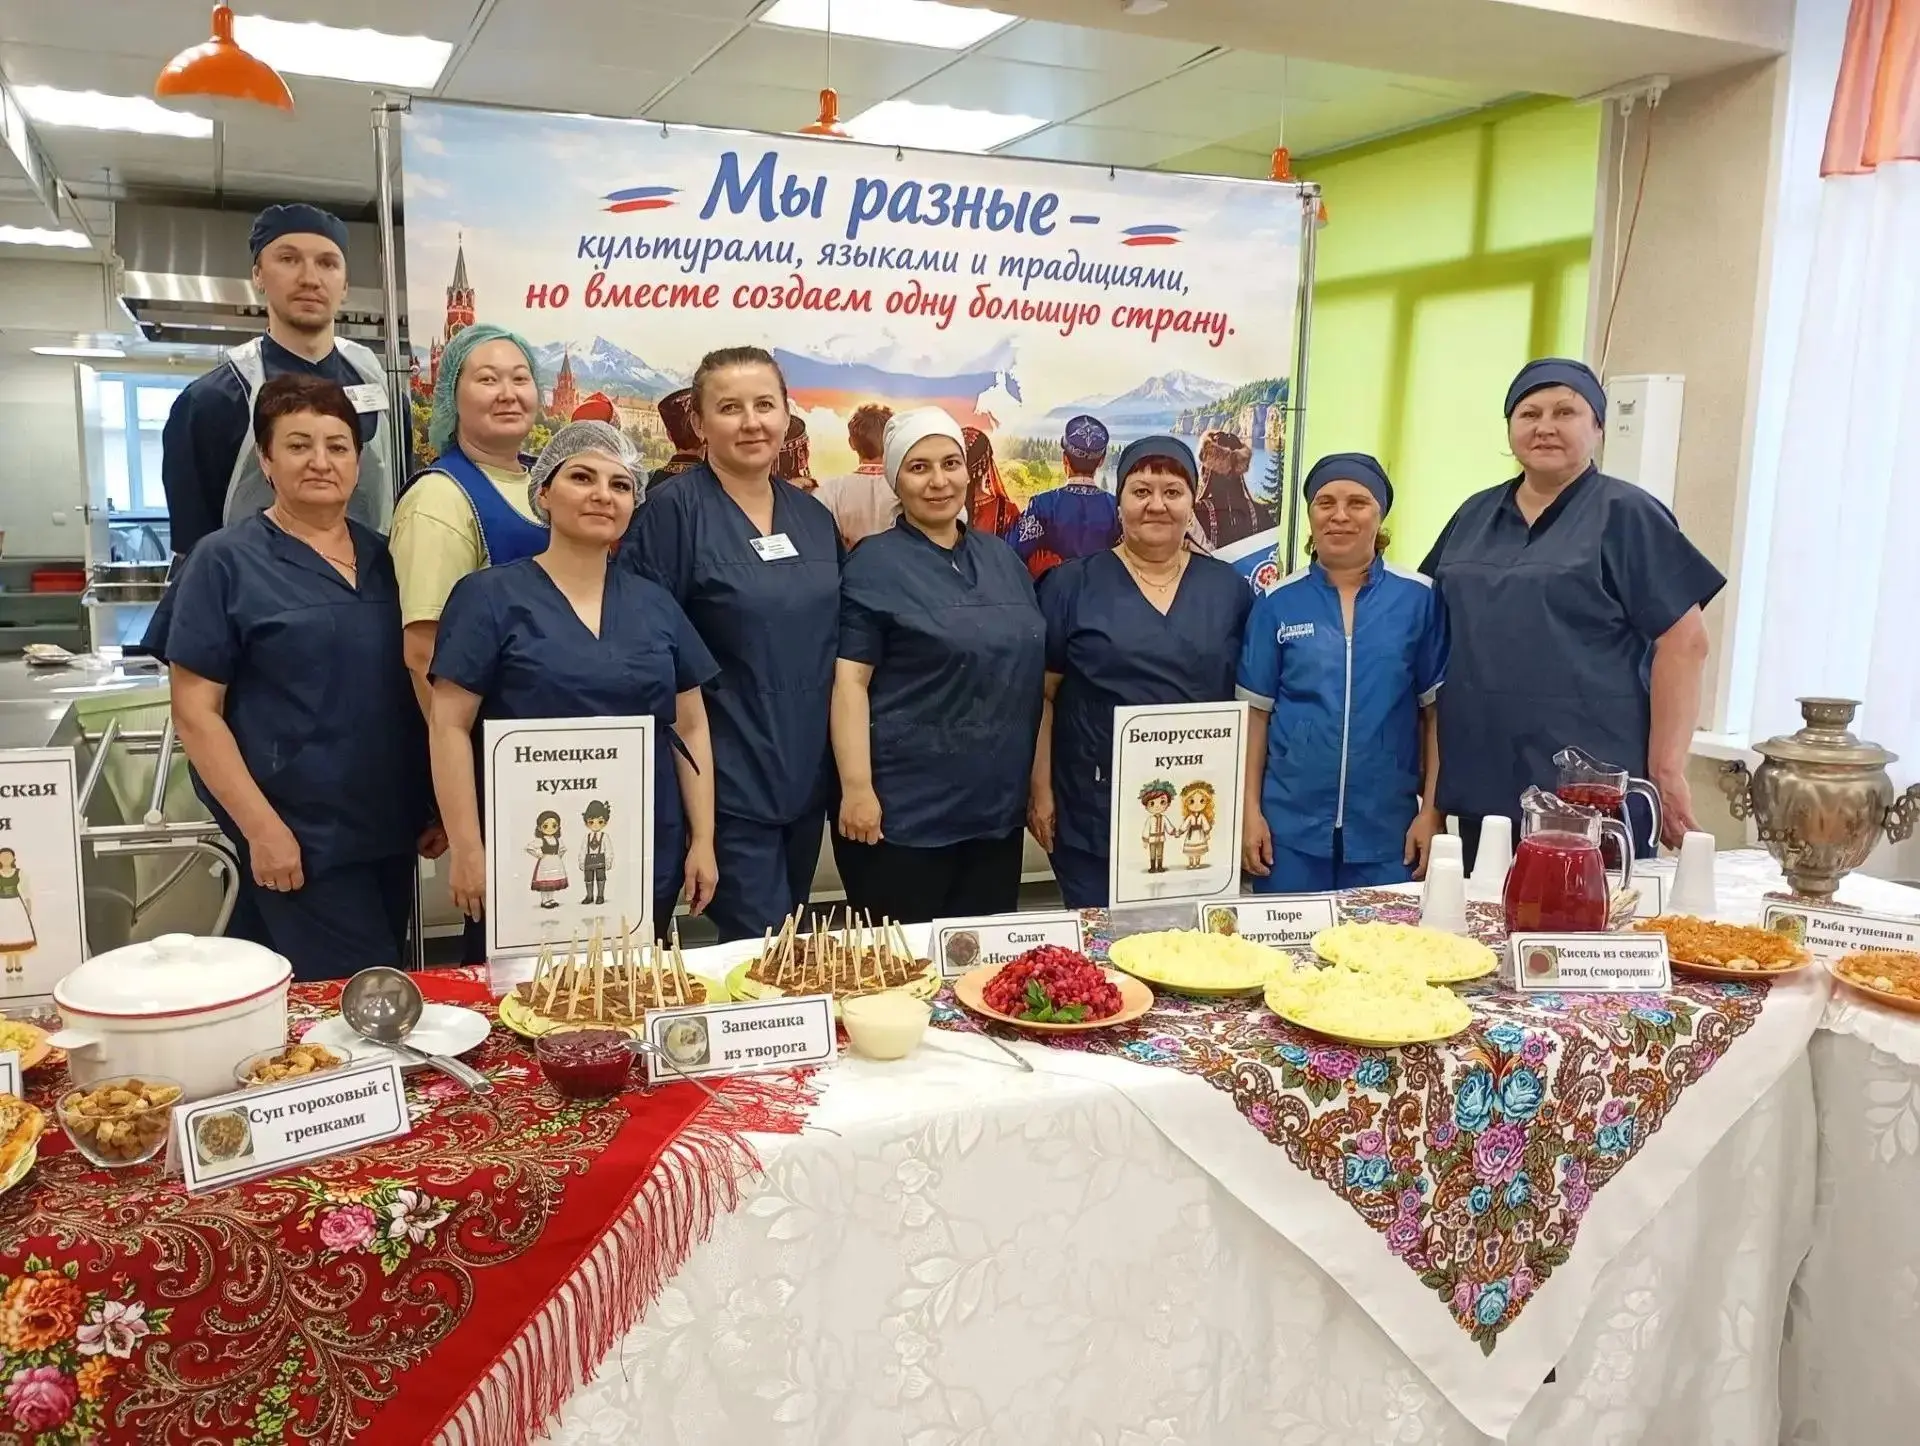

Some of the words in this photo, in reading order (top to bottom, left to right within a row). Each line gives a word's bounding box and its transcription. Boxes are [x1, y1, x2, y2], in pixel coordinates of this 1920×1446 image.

[699, 151, 828, 222] Мы
[845, 176, 1059, 240] разные
[577, 234, 804, 274] культурами,
[817, 242, 957, 273] языками
[971, 252, 986, 276] и
[999, 249, 1189, 296] традициями,
[525, 282, 569, 309] но
[584, 271, 720, 310] вместе
[733, 274, 873, 312] создаем
[886, 279, 957, 330] одну
[968, 283, 1101, 337] большую
[1111, 304, 1235, 347] страну.
[1129, 727, 1232, 744] Белорусская
[514, 745, 618, 763] Немецкая
[1155, 754, 1204, 770] кухня
[536, 777, 598, 795] кухня
[1266, 909, 1303, 922] Пюре
[1007, 931, 1046, 944] Салат
[1812, 918, 1845, 932] Рыба
[1848, 924, 1903, 941] тушеная
[1906, 934, 1915, 942] в
[1804, 935, 1848, 949] томате
[1850, 941, 1858, 950] с
[1557, 947, 1600, 959] Кисель
[1603, 949, 1617, 959] из
[1560, 968, 1588, 978] ягод
[721, 1015, 805, 1034] Запеканка
[724, 1049, 743, 1061] из
[745, 1041, 807, 1058] творога
[250, 1106, 285, 1125] Суп
[288, 1081, 378, 1115] гороховый
[382, 1081, 391, 1093] с
[285, 1112, 366, 1143] гренками
